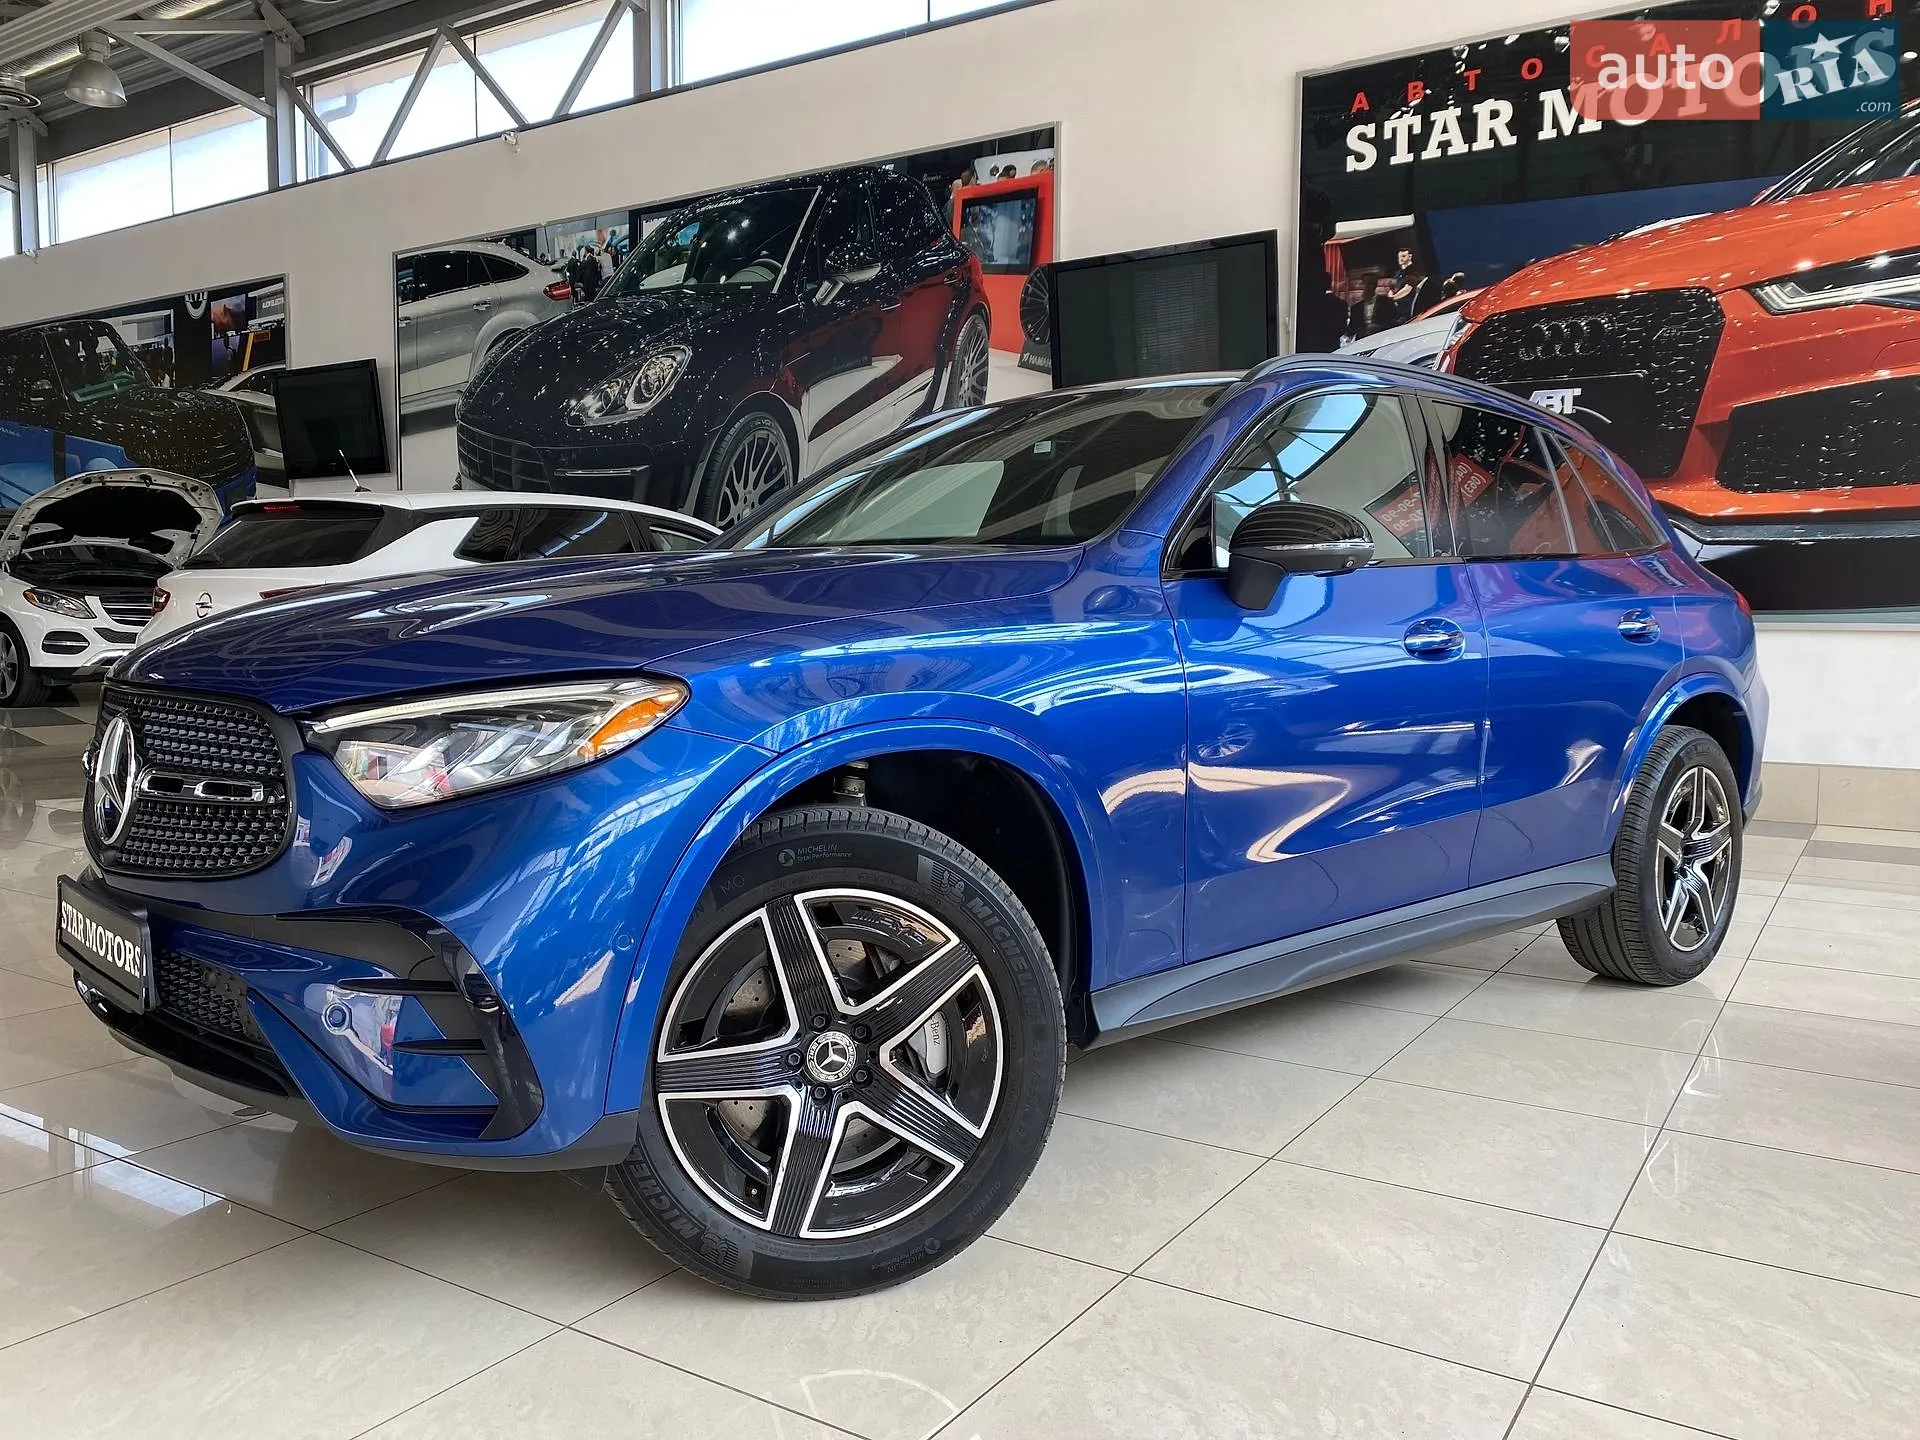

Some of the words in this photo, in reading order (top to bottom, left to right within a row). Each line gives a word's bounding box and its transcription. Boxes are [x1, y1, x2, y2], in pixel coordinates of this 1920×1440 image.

[1346, 98, 1518, 173] STAR
[1529, 387, 1582, 415] ABT
[719, 873, 746, 897] MO
[797, 842, 839, 855] MICHELIN
[60, 899, 85, 945] STAR
[86, 917, 141, 979] MOTORS
[967, 896, 1048, 1025] MICHELIN
[626, 1146, 701, 1240] MICHEL
